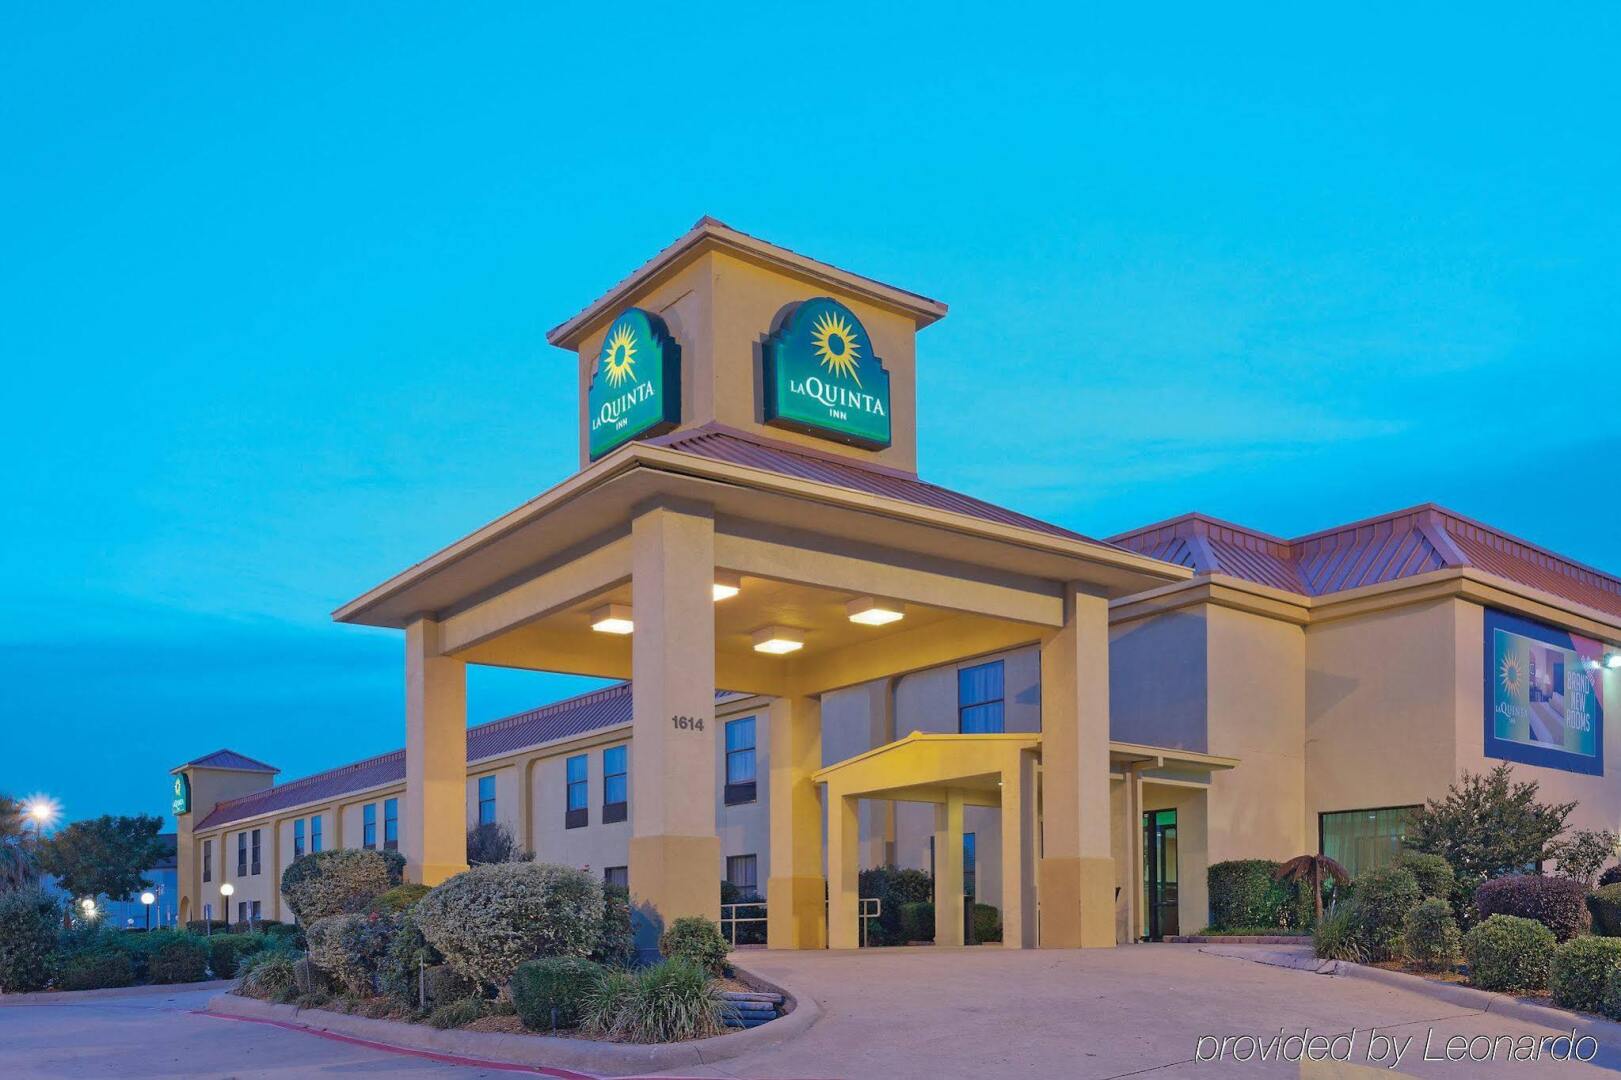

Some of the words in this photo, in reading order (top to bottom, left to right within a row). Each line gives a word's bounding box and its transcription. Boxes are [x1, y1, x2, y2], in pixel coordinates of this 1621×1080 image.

[829, 408, 847, 420] INN
[616, 417, 628, 431] INN
[1567, 671, 1590, 694] BRAND
[1570, 691, 1586, 713] NEW
[672, 715, 704, 731] 1614
[1566, 708, 1591, 732] ROOMS
